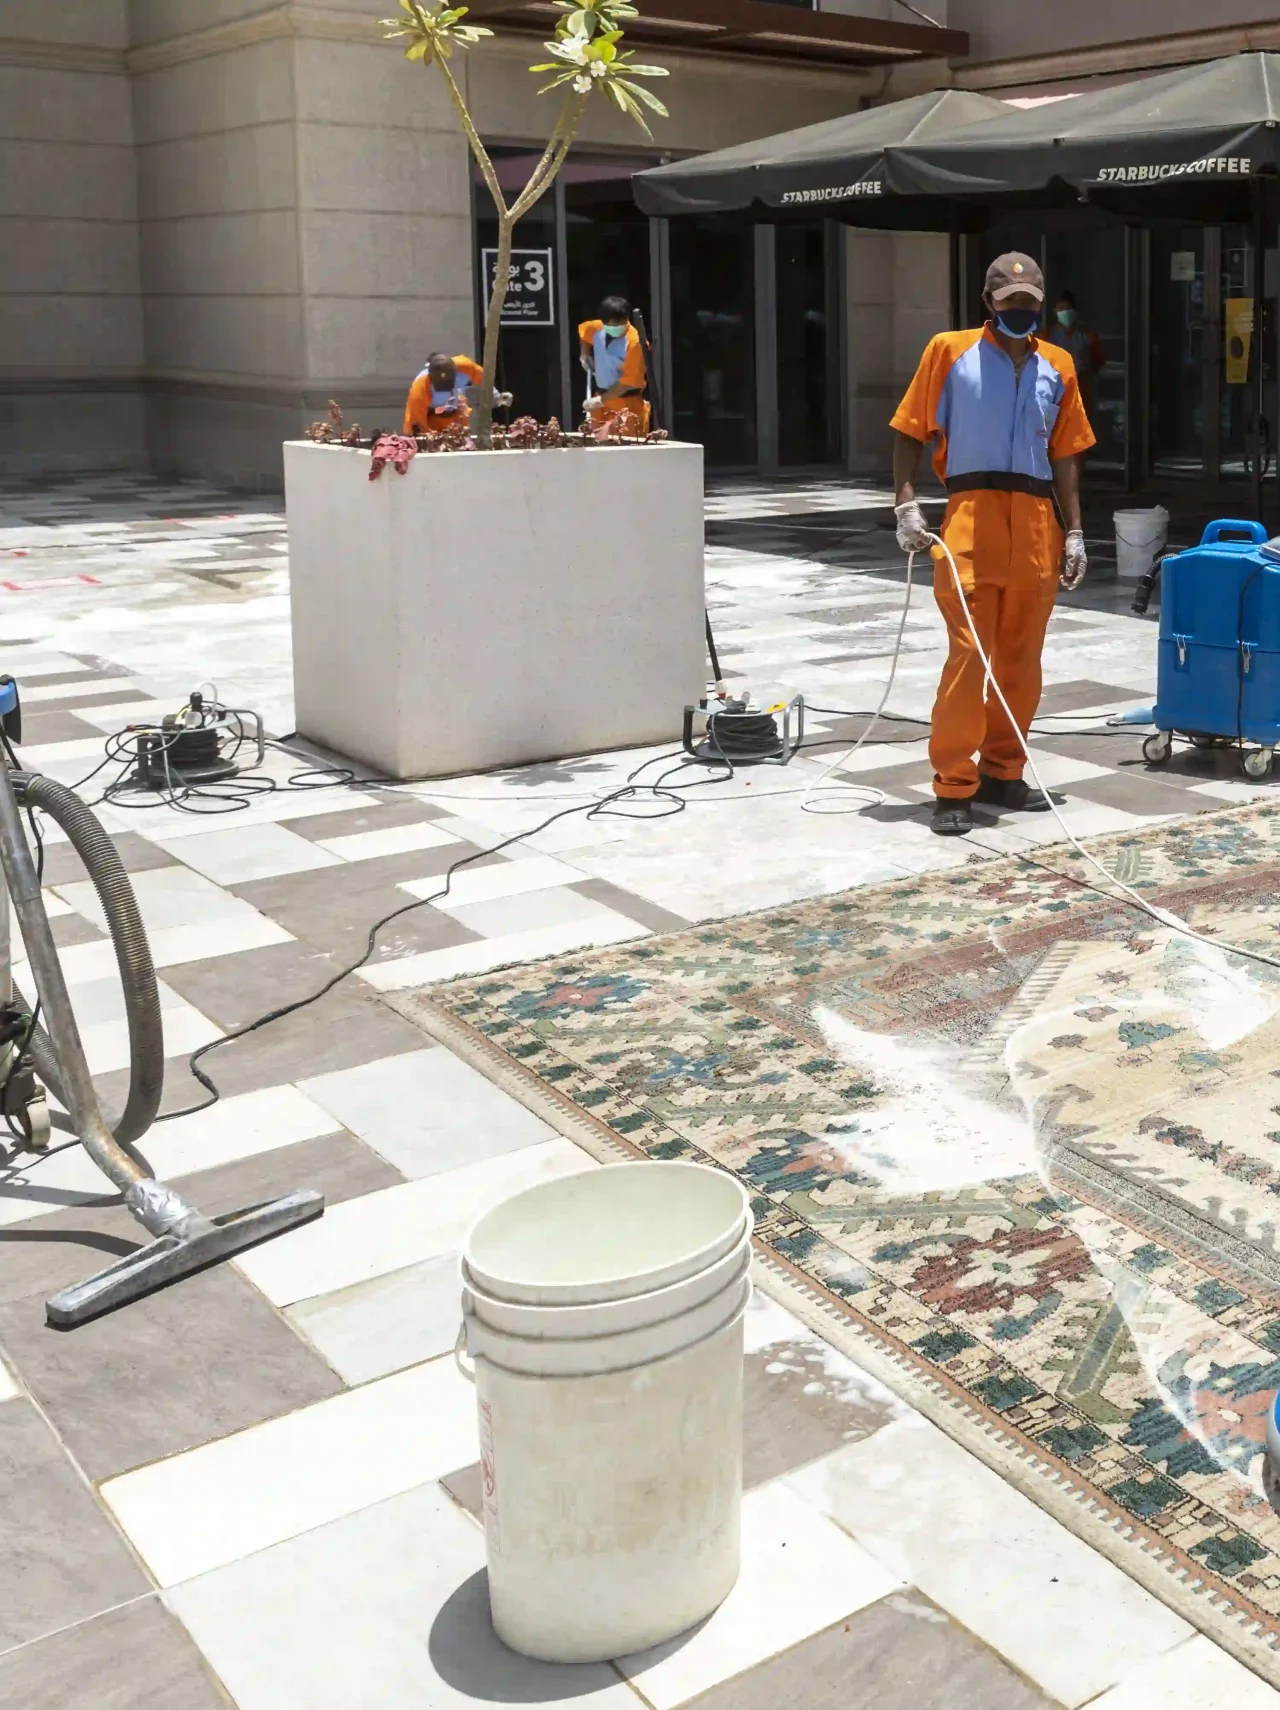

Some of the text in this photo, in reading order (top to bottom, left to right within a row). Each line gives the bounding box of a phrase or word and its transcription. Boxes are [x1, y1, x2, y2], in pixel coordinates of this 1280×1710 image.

[1097, 157, 1251, 182] STARBUCKS COFFEE
[780, 186, 844, 203] STARBUCKS
[524, 261, 545, 292] 3
